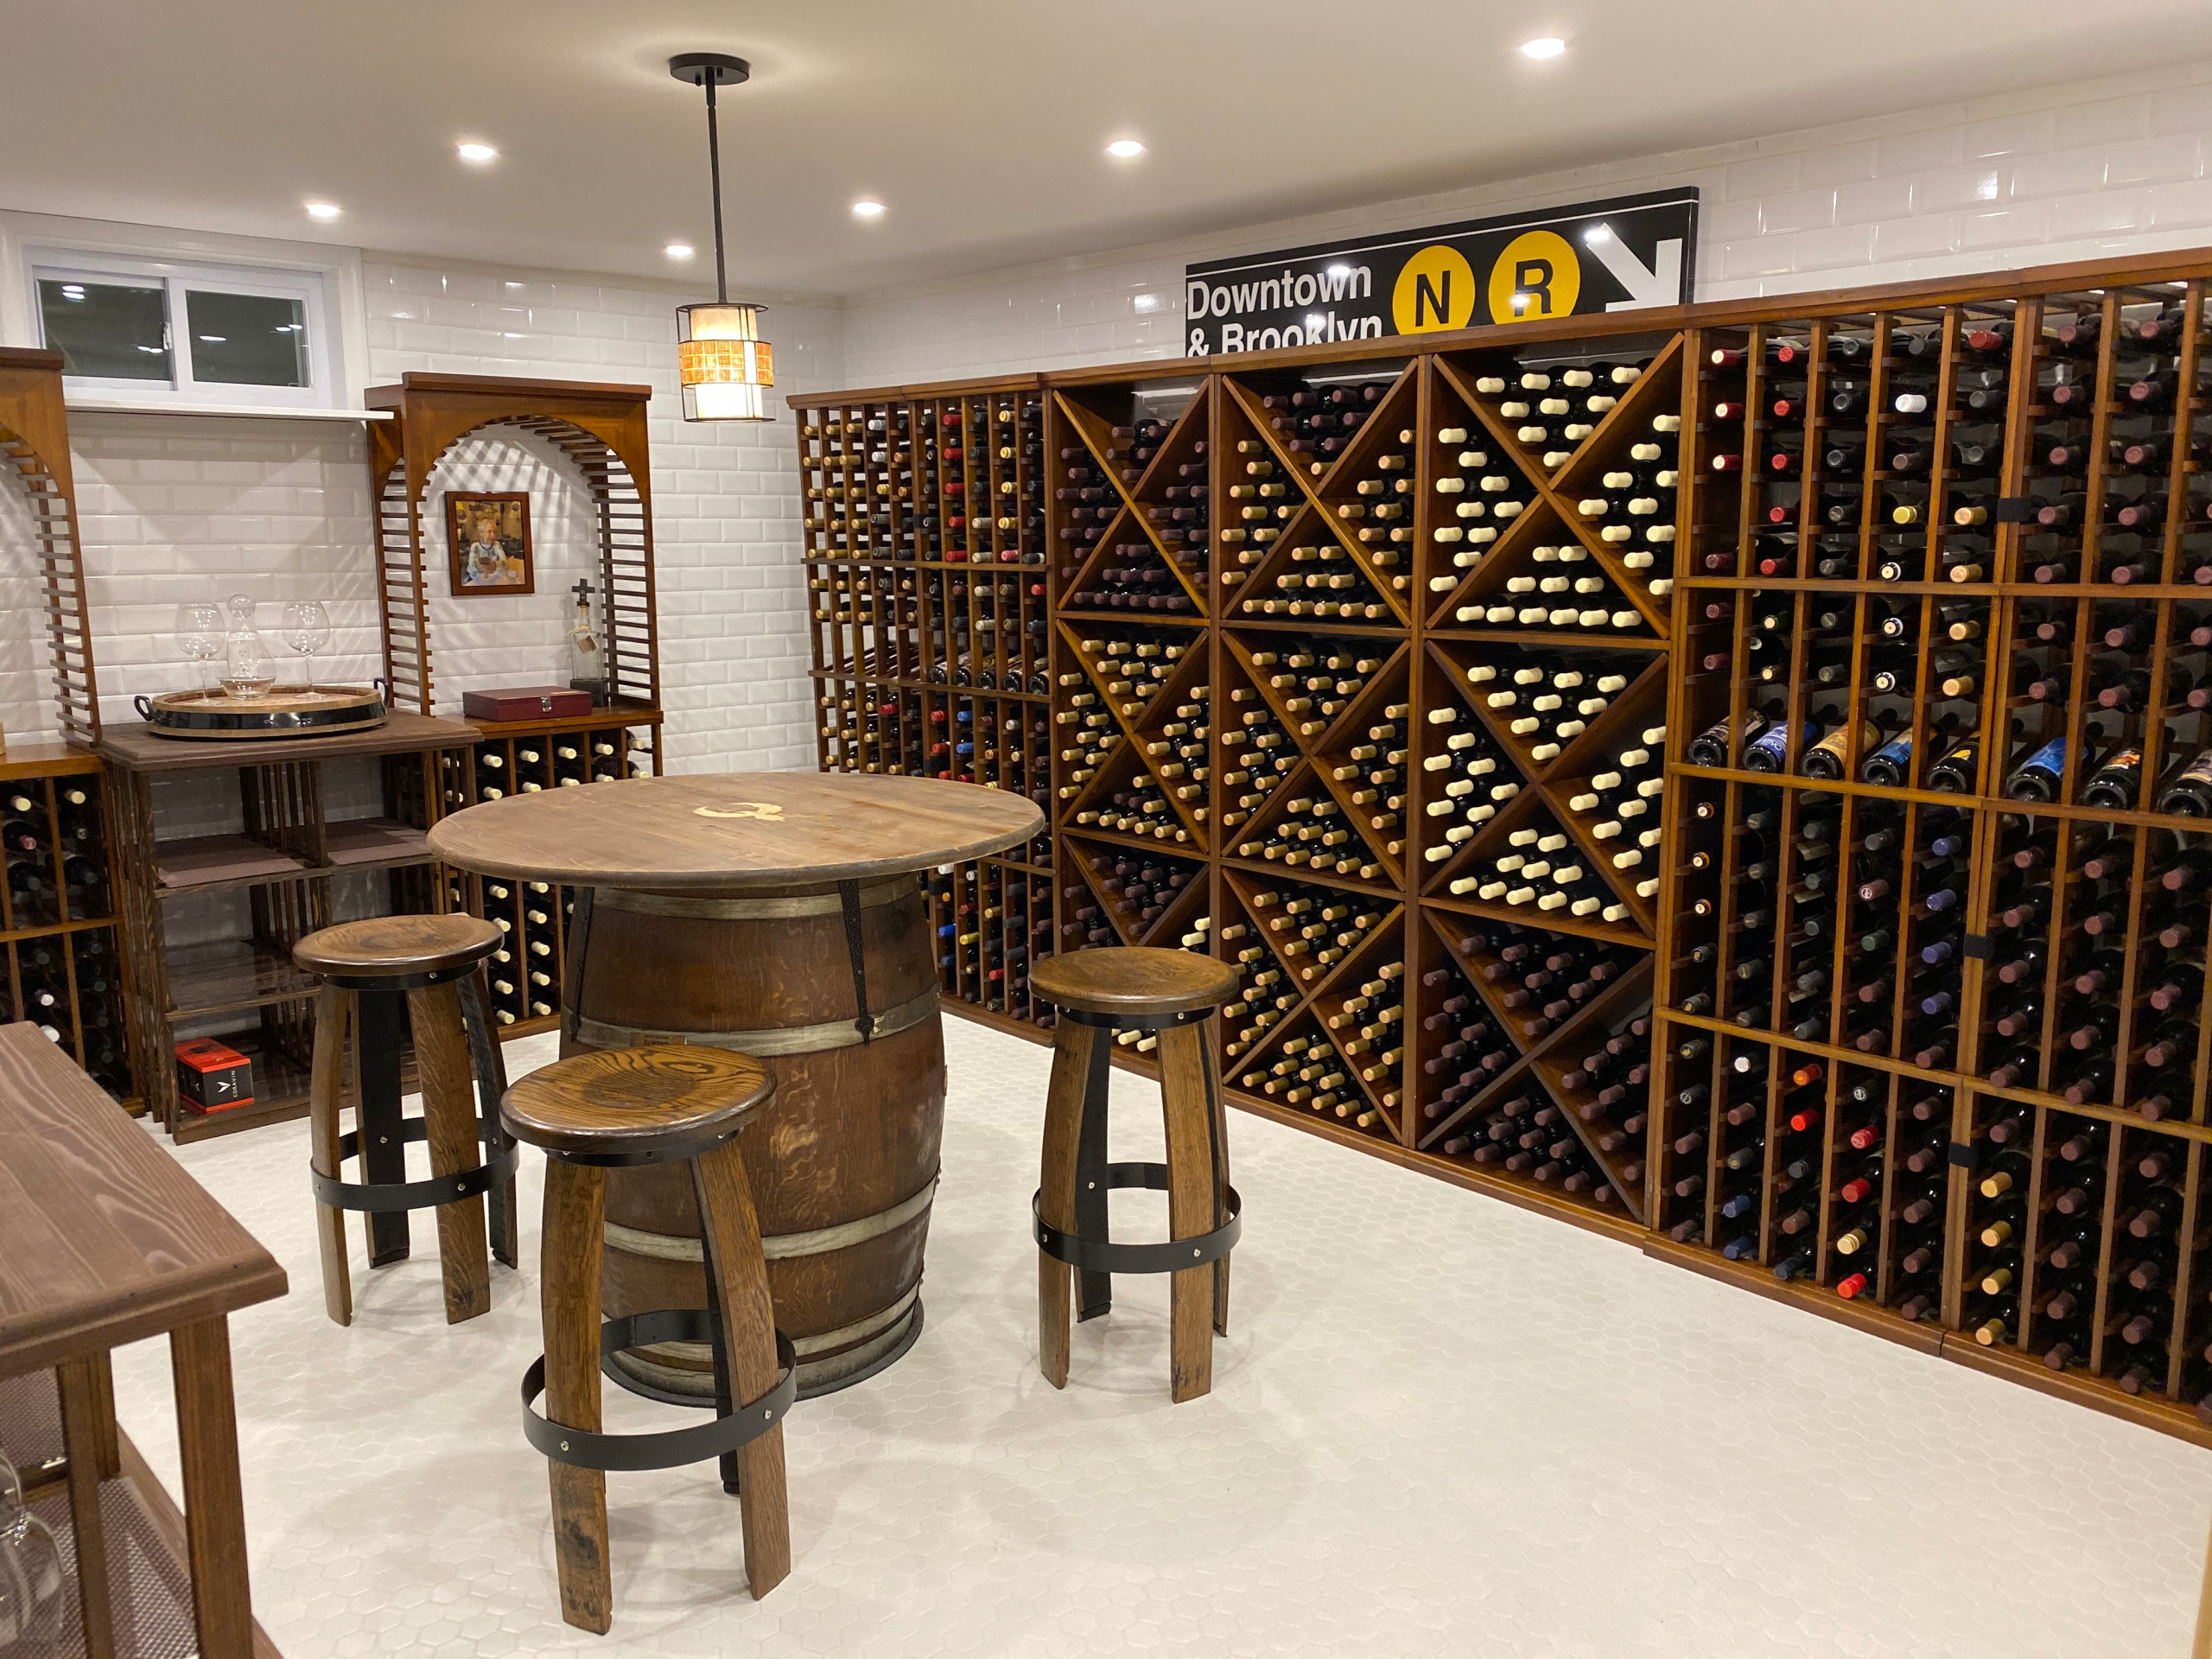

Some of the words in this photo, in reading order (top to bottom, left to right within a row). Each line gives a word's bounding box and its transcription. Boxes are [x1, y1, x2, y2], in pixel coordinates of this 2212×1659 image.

[1187, 265, 1371, 320] Downtown
[1414, 270, 1451, 327] N
[1514, 258, 1553, 317] R
[1187, 327, 1210, 358] &
